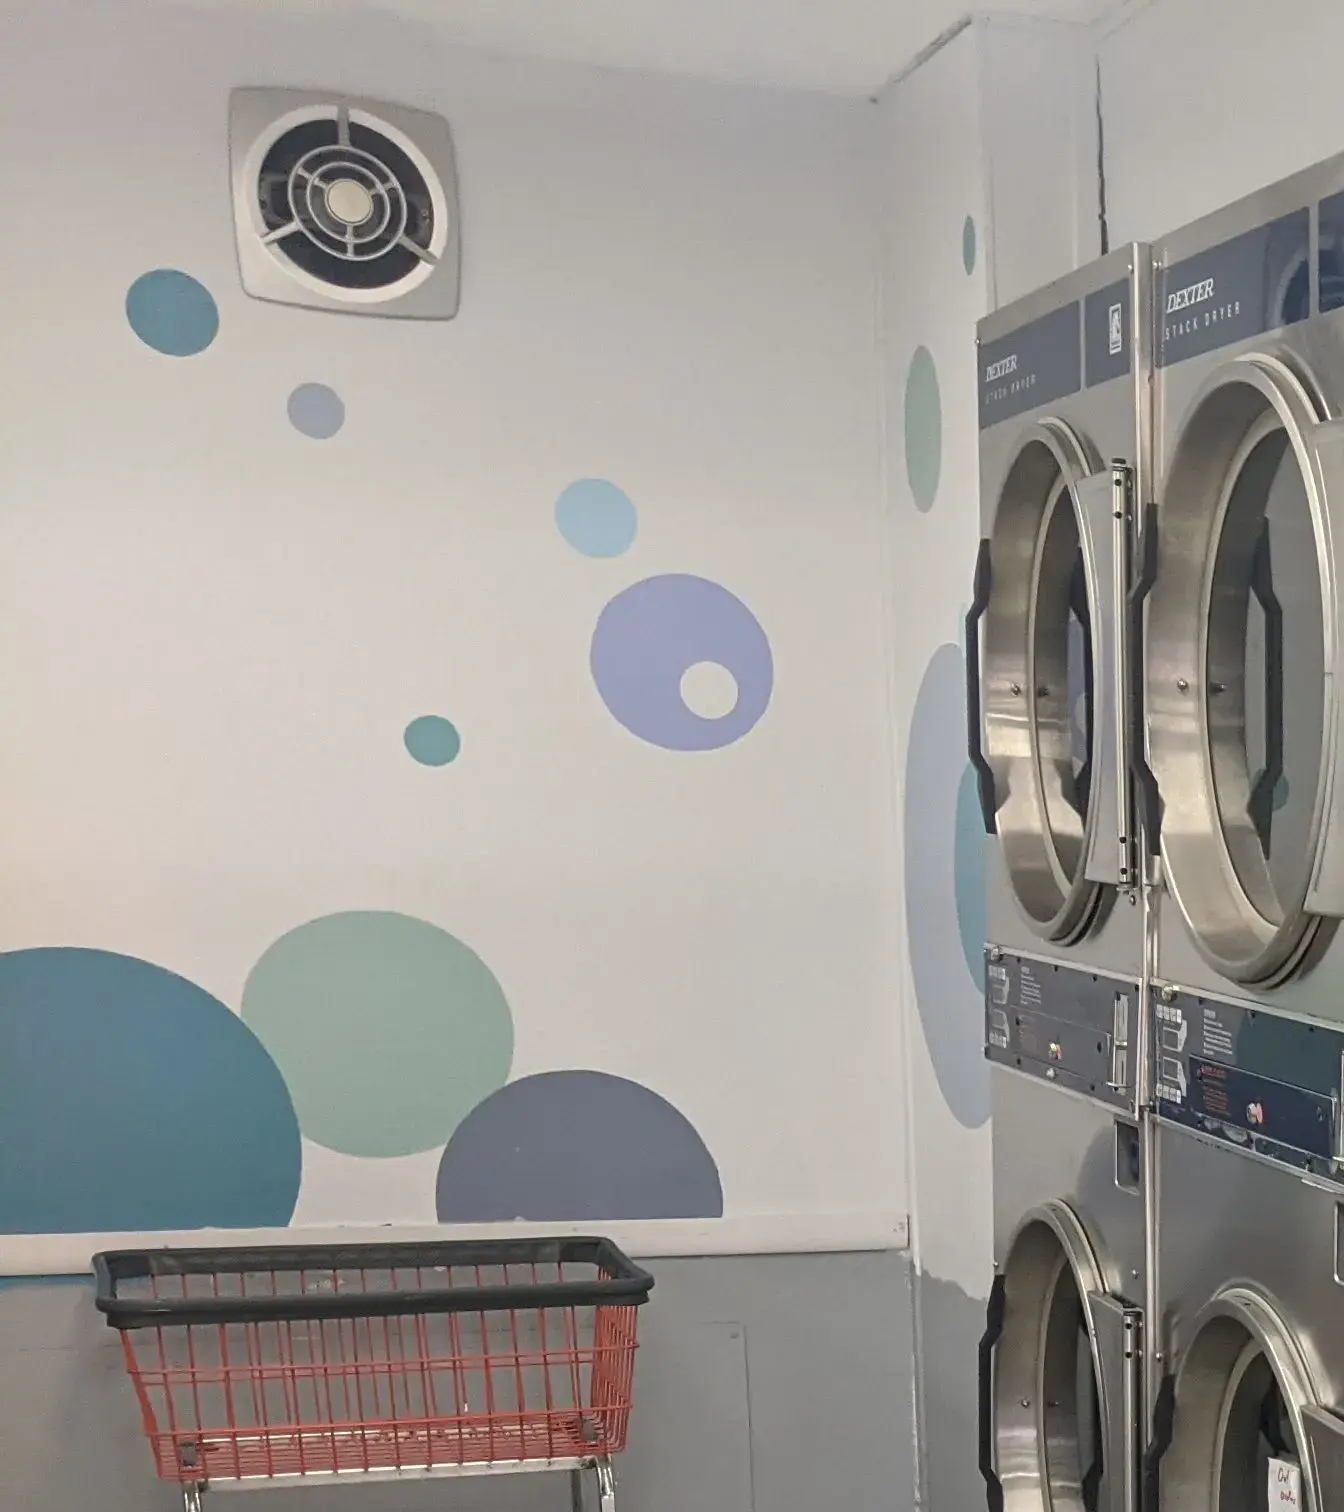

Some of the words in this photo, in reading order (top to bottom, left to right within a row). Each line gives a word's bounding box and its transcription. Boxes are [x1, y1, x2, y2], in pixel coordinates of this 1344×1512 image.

[1166, 277, 1215, 314] DEXTER
[1165, 317, 1198, 341] STACK
[1204, 301, 1240, 327] DRYER
[984, 354, 1018, 383] DEXTER
